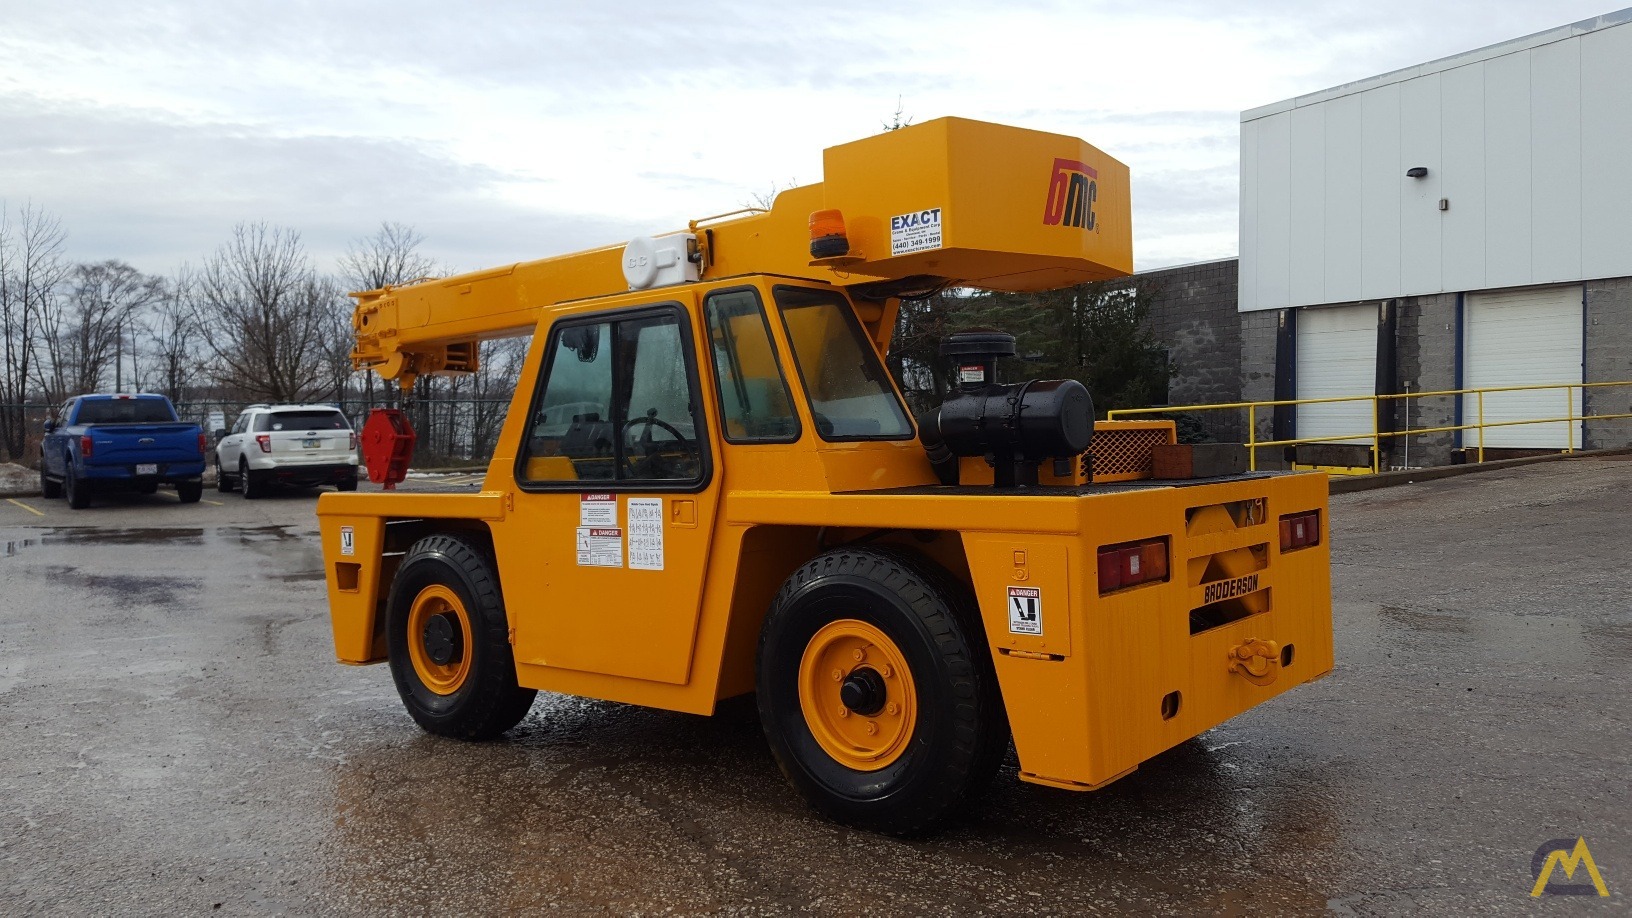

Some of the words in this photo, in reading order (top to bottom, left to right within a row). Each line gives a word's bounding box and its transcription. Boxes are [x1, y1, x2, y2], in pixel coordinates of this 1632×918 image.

[892, 209, 940, 230] EXACT
[893, 241, 909, 250] (440)
[911, 236, 940, 246] 349-1999
[1204, 573, 1259, 604] BRODERSON
